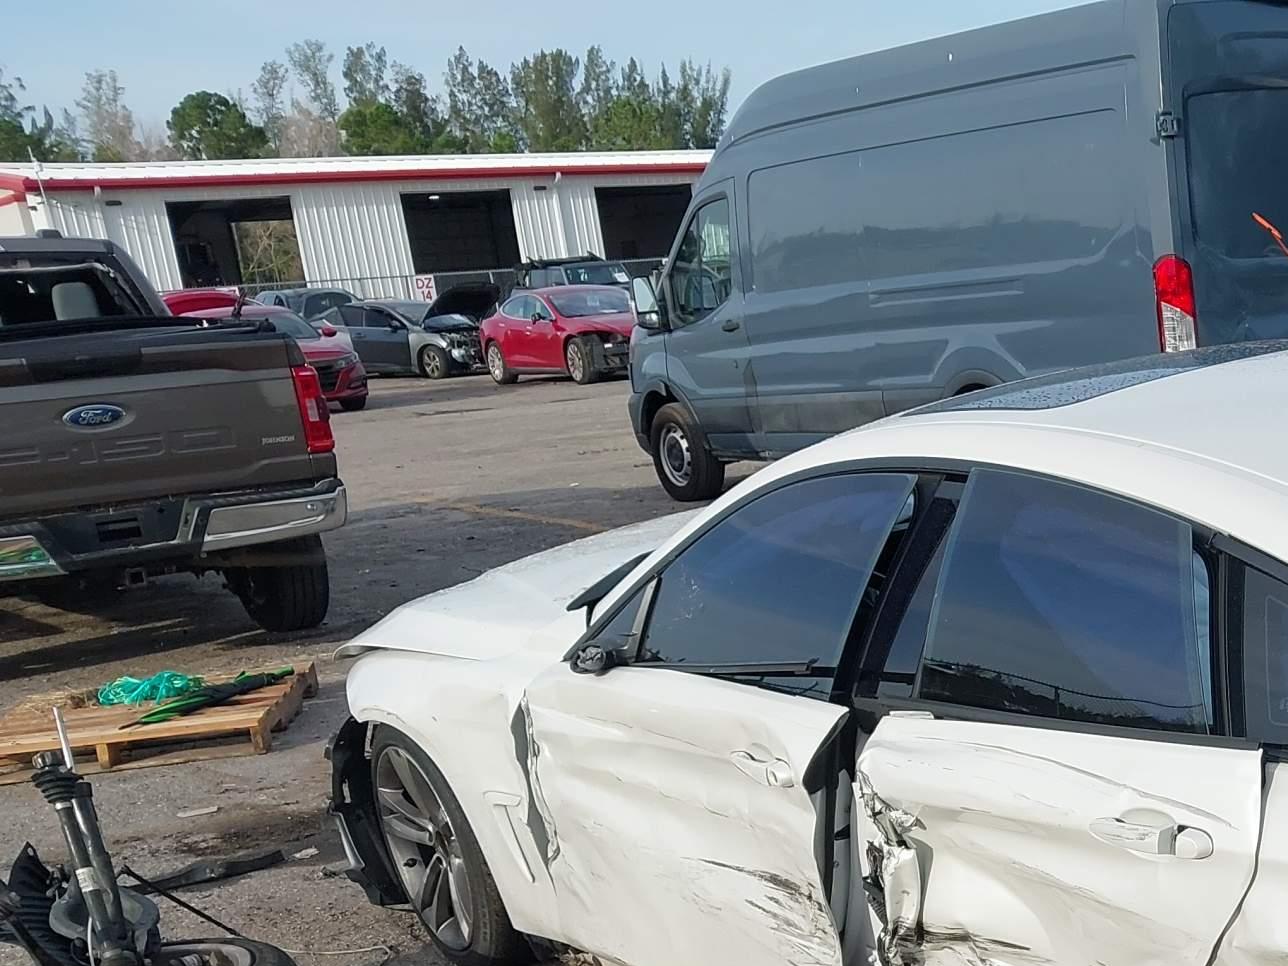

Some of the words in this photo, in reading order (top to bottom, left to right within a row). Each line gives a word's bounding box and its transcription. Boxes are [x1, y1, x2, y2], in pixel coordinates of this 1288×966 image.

[416, 277, 433, 289] DZ
[421, 290, 433, 301] 14
[78, 410, 113, 425] Ford
